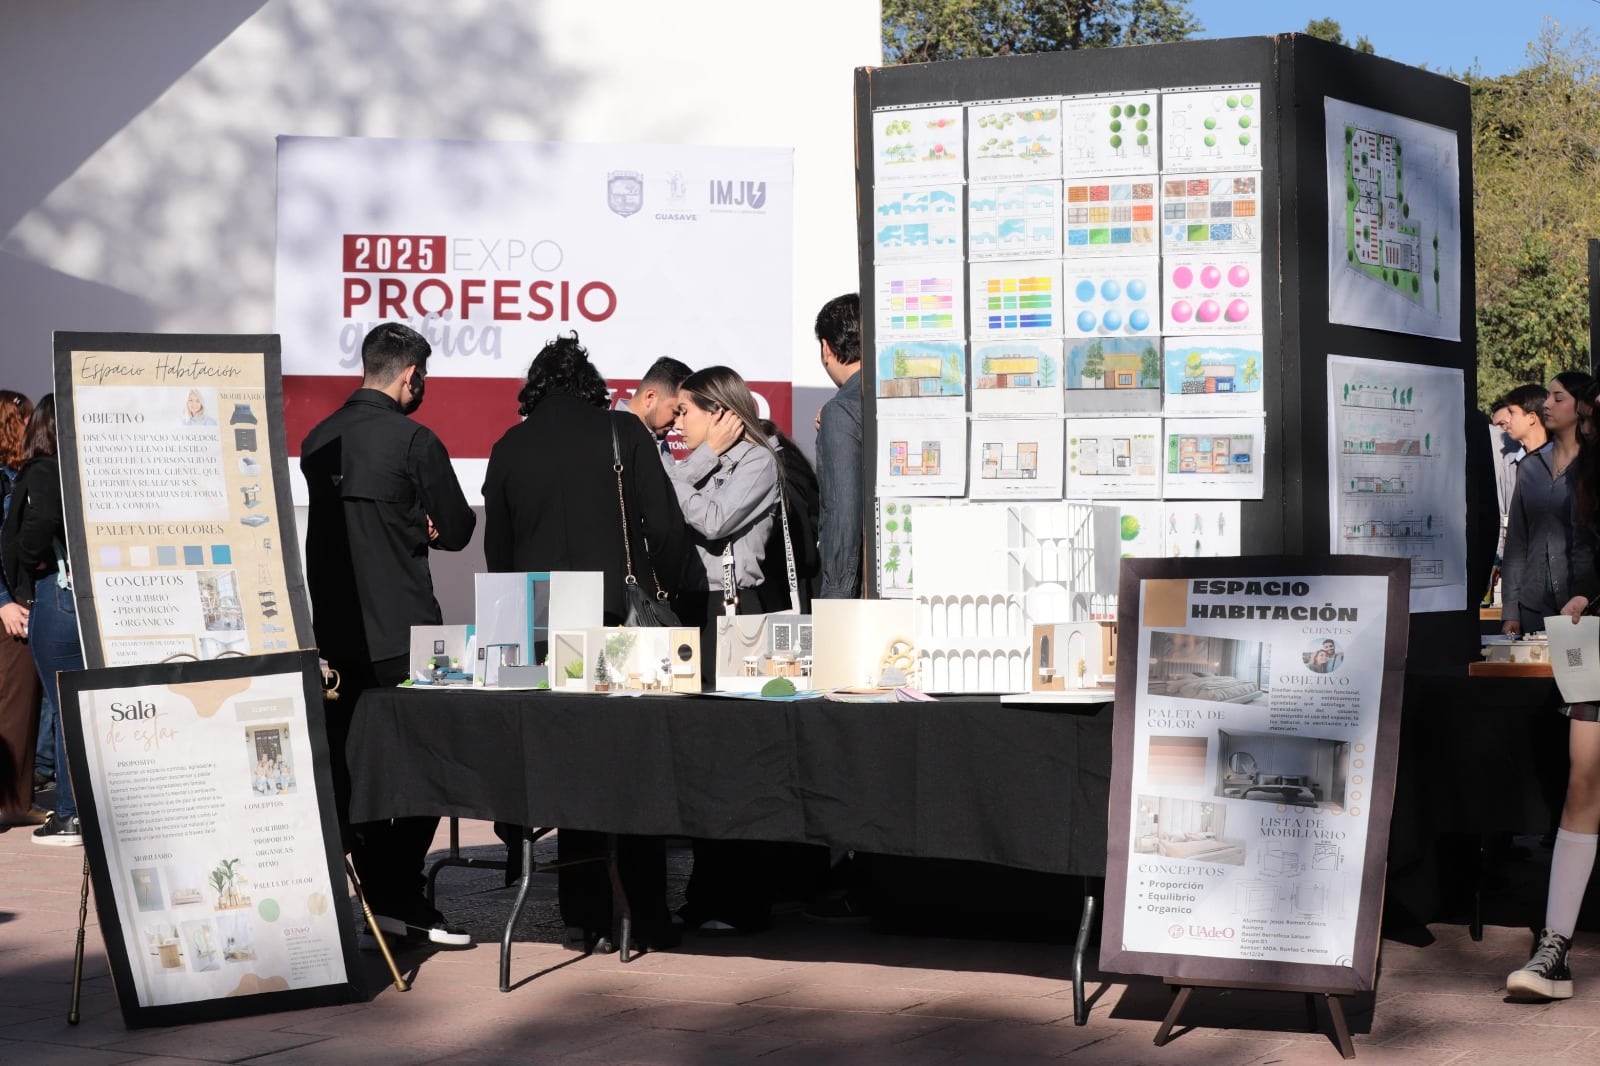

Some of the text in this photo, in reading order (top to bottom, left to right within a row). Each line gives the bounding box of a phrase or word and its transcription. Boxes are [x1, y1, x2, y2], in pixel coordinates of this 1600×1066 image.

[655, 213, 697, 221] GUASAVE
[354, 236, 564, 272] 2025 EXPO
[343, 278, 618, 323] PROFESIO
[80, 355, 242, 384] Espacio Habitación
[82, 413, 145, 425] OBJETIVO
[83, 432, 118, 442] DISEÑAR
[134, 434, 169, 442] ESPACIO
[84, 445, 127, 453] LUMINOSO
[85, 457, 102, 466] QUE
[96, 524, 224, 536] PALETA DE COLORES
[105, 575, 184, 587] CONCEPTOS
[1192, 581, 1310, 597] ESPACIO
[116, 594, 170, 604] EQUILIBRIO
[1191, 603, 1359, 622] HABITACIÓN
[120, 618, 175, 627] ORGANICAS
[1301, 626, 1352, 635] CLIENTES
[1279, 675, 1350, 686] OBJETIVO
[110, 700, 156, 722] Sala
[1147, 708, 1226, 720] PALETA DE
[1146, 718, 1197, 729] COLOR
[106, 712, 178, 752] de estar
[1260, 817, 1324, 829] LISTA DE
[1260, 827, 1346, 840] MOBILIARIO
[1138, 864, 1226, 877] CONCEPTOS
[1149, 879, 1204, 892] Proporción
[1147, 891, 1196, 903] Equilibrio
[1146, 904, 1192, 916] Organico
[1188, 925, 1236, 939] UAdeO
